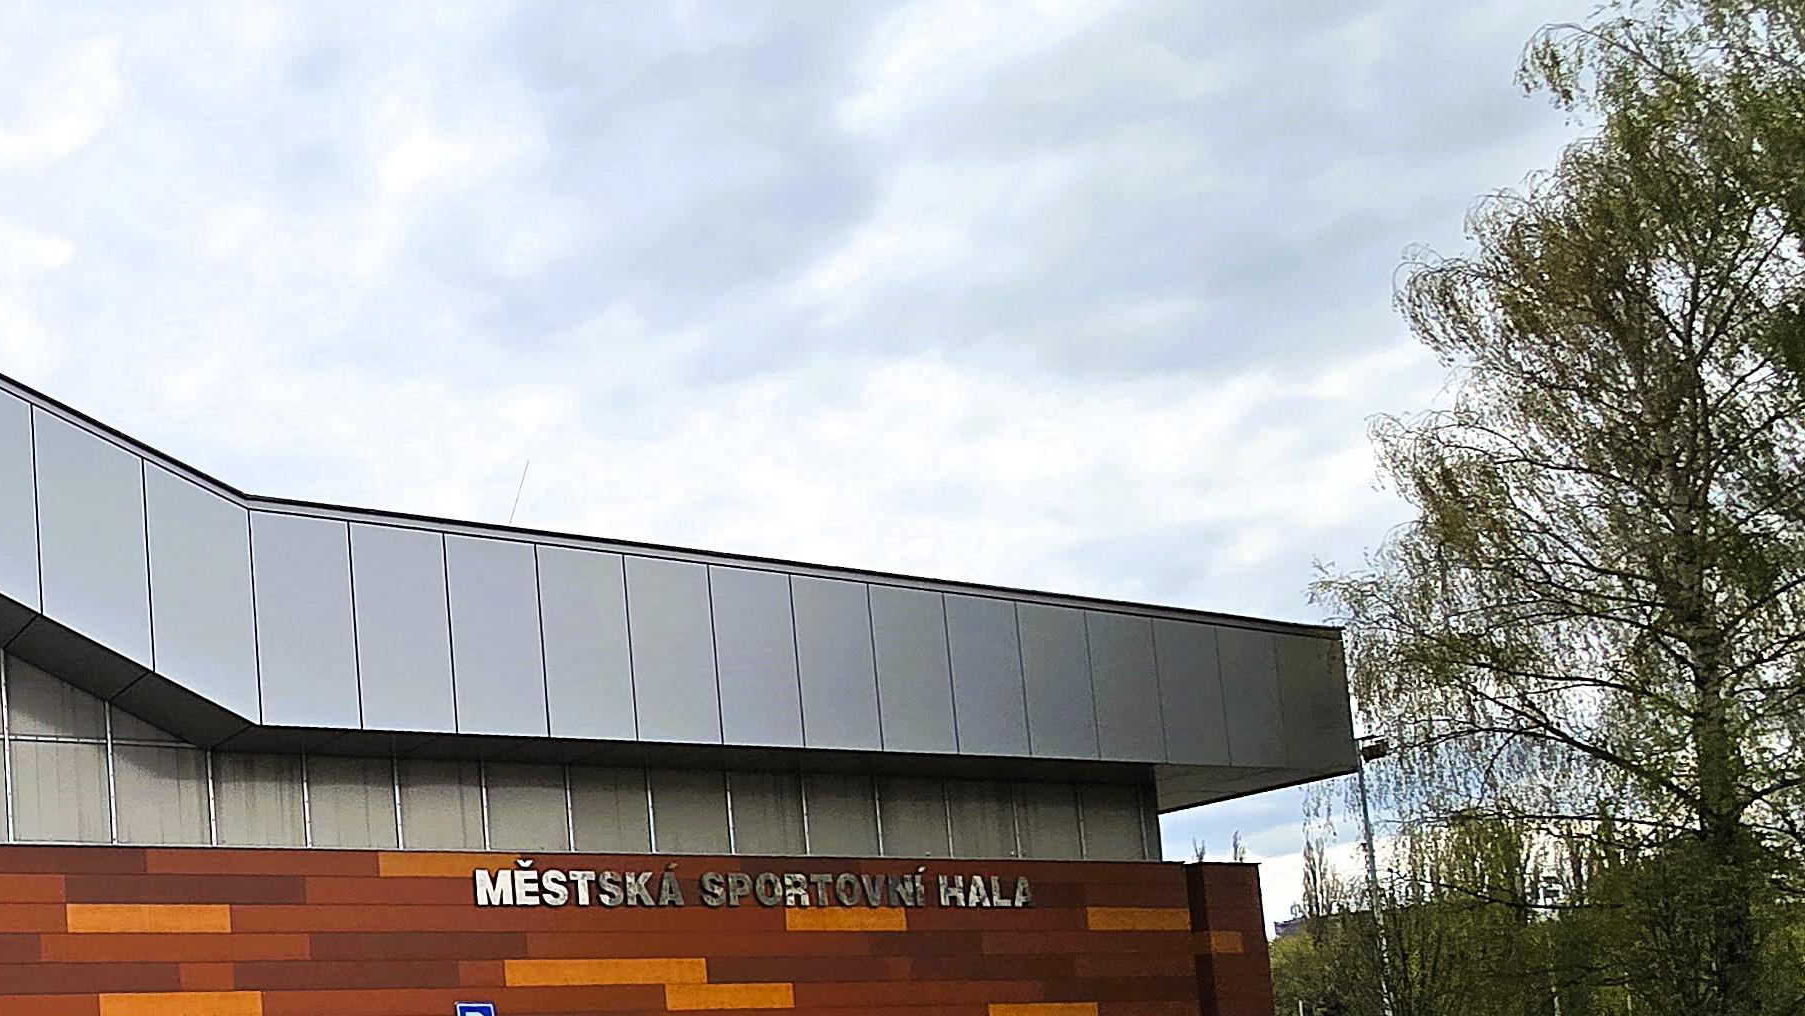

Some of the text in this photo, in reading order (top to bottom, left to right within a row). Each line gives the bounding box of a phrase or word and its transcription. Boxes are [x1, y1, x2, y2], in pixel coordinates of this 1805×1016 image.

[475, 859, 1034, 907] MĚSTSKÁ SPORTOVNÍ HALA
